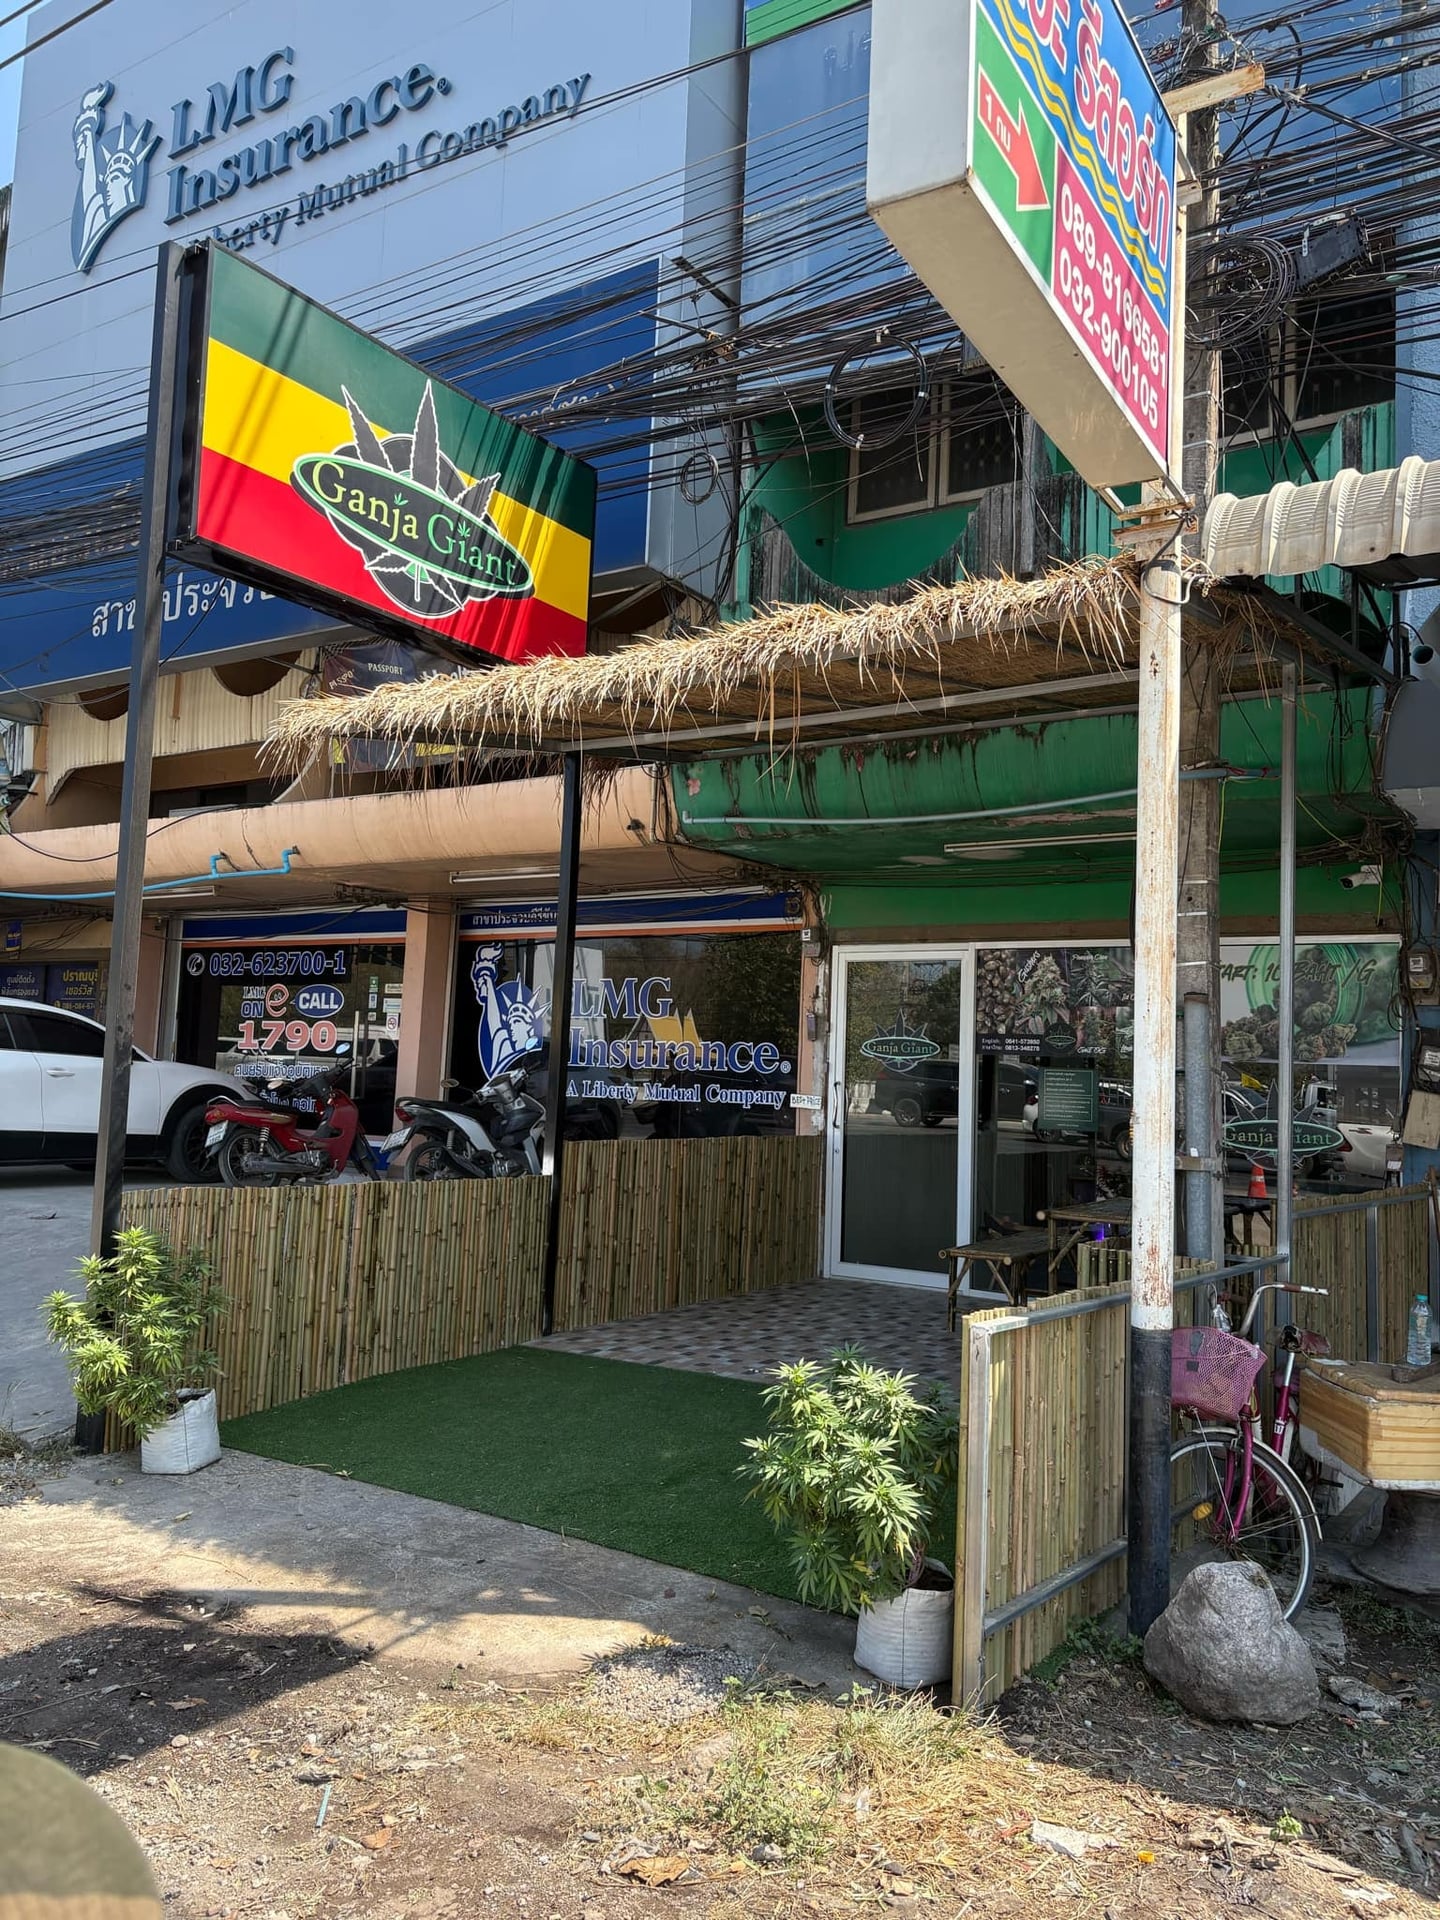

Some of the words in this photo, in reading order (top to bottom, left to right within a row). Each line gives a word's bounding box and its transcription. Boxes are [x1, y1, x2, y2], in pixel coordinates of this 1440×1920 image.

[167, 46, 295, 160] LMG
[985, 93, 993, 122] 1
[188, 207, 290, 252] berty
[294, 143, 409, 226] Mutual
[415, 72, 592, 168] Company
[1061, 182, 1168, 390] 089-8166581
[1059, 247, 1159, 430] 032-900105
[312, 460, 419, 543] Ganja
[427, 512, 517, 586] Giant
[367, 662, 404, 676] PASSPORT
[209, 950, 346, 976] 032-623700-1
[240, 1001, 265, 1018] ON
[299, 992, 340, 1010] CALL
[569, 976, 674, 1020] LMG
[237, 1020, 338, 1052] 1790
[867, 1041, 898, 1054] Ganja
[901, 1041, 934, 1054] Giant
[565, 1081, 578, 1097] A
[583, 1080, 638, 1103] Liberty
[644, 1083, 701, 1103] Mutual
[706, 1084, 787, 1109] Company
[1224, 1126, 1274, 1147] Ganja
[1295, 1126, 1332, 1145] iant
